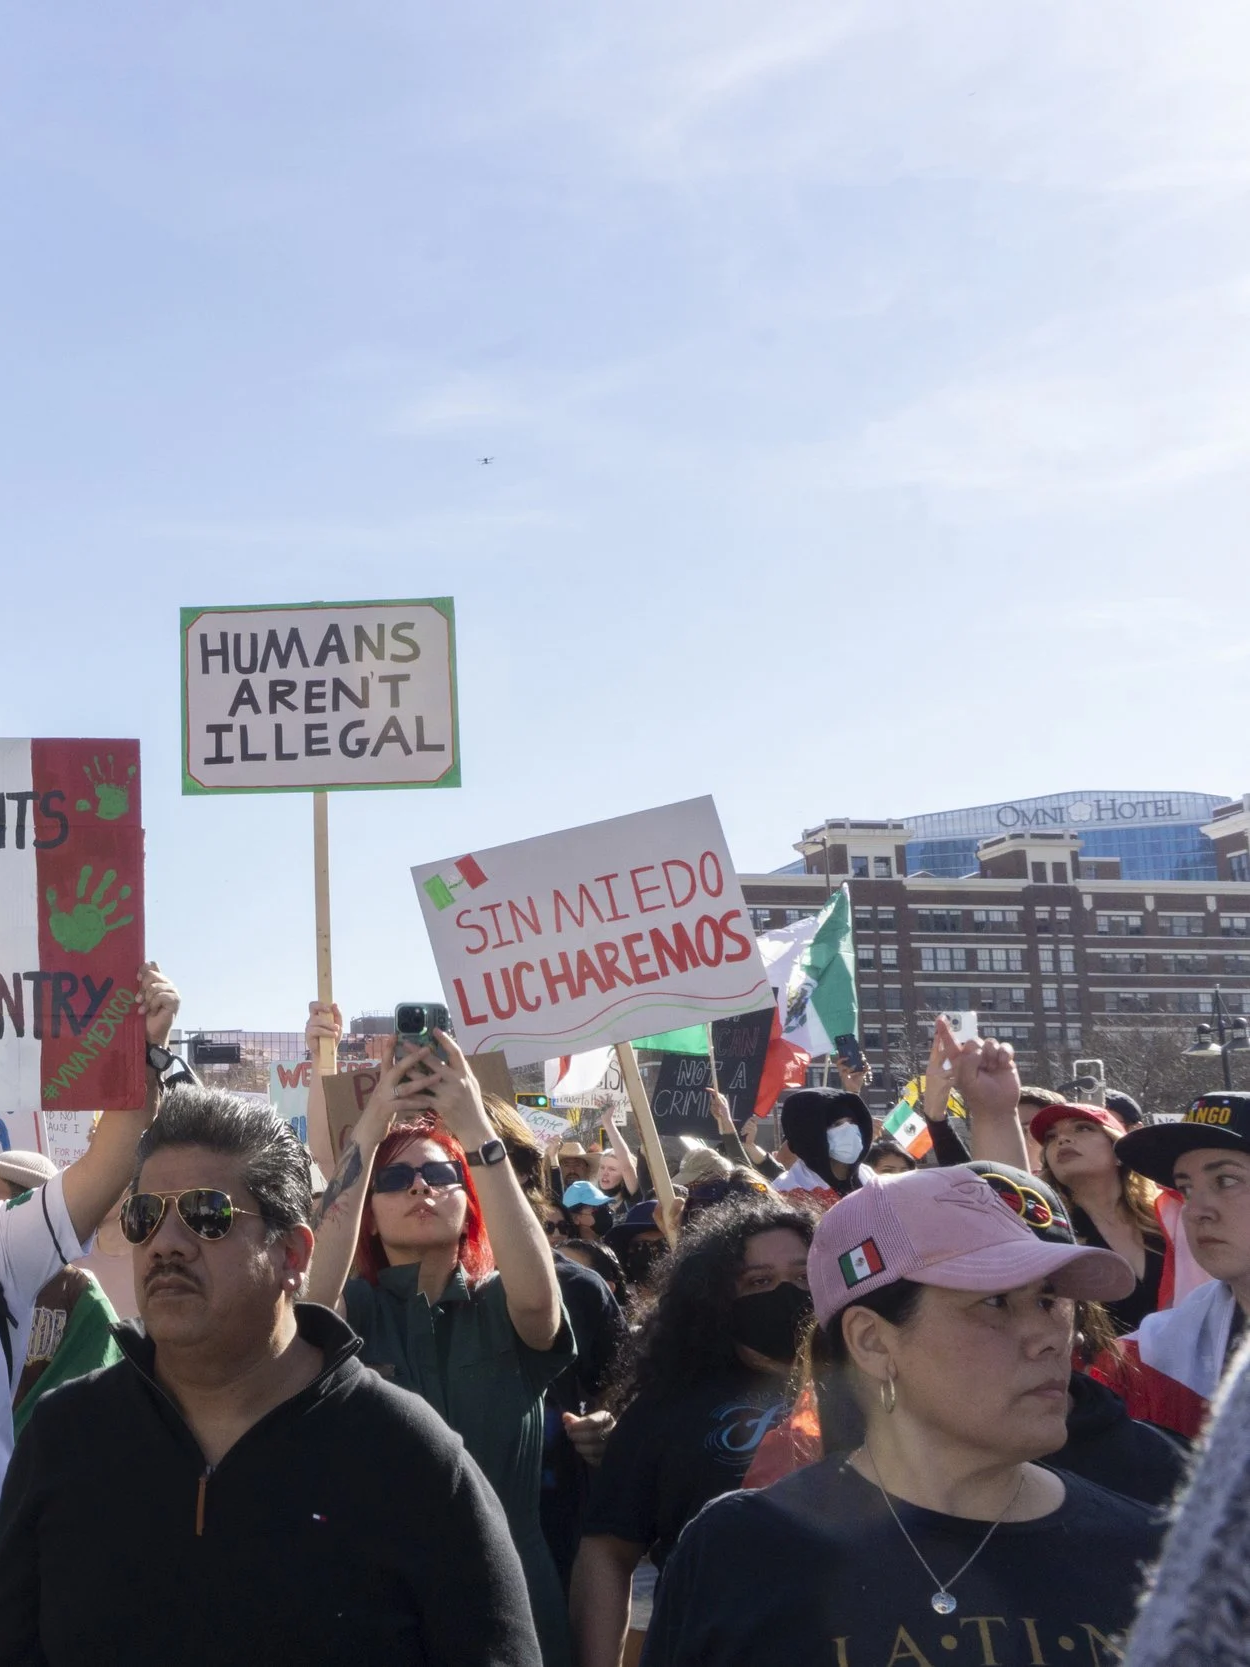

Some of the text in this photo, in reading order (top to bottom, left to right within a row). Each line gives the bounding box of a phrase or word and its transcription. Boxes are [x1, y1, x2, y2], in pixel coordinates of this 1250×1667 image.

[200, 621, 421, 676] HUMANS
[228, 671, 410, 717] AREN'T
[204, 714, 445, 766] ILLEGAL
[996, 799, 1181, 828] OMNI HOTEL
[454, 849, 725, 955] SIN MIEDO
[453, 909, 751, 1027] LUCHAREMOS
[676, 1059, 747, 1089] NOT A
[653, 1089, 742, 1122] CRIMIL
[1181, 1106, 1232, 1125] ANGO
[74, 1123, 80, 1134] I
